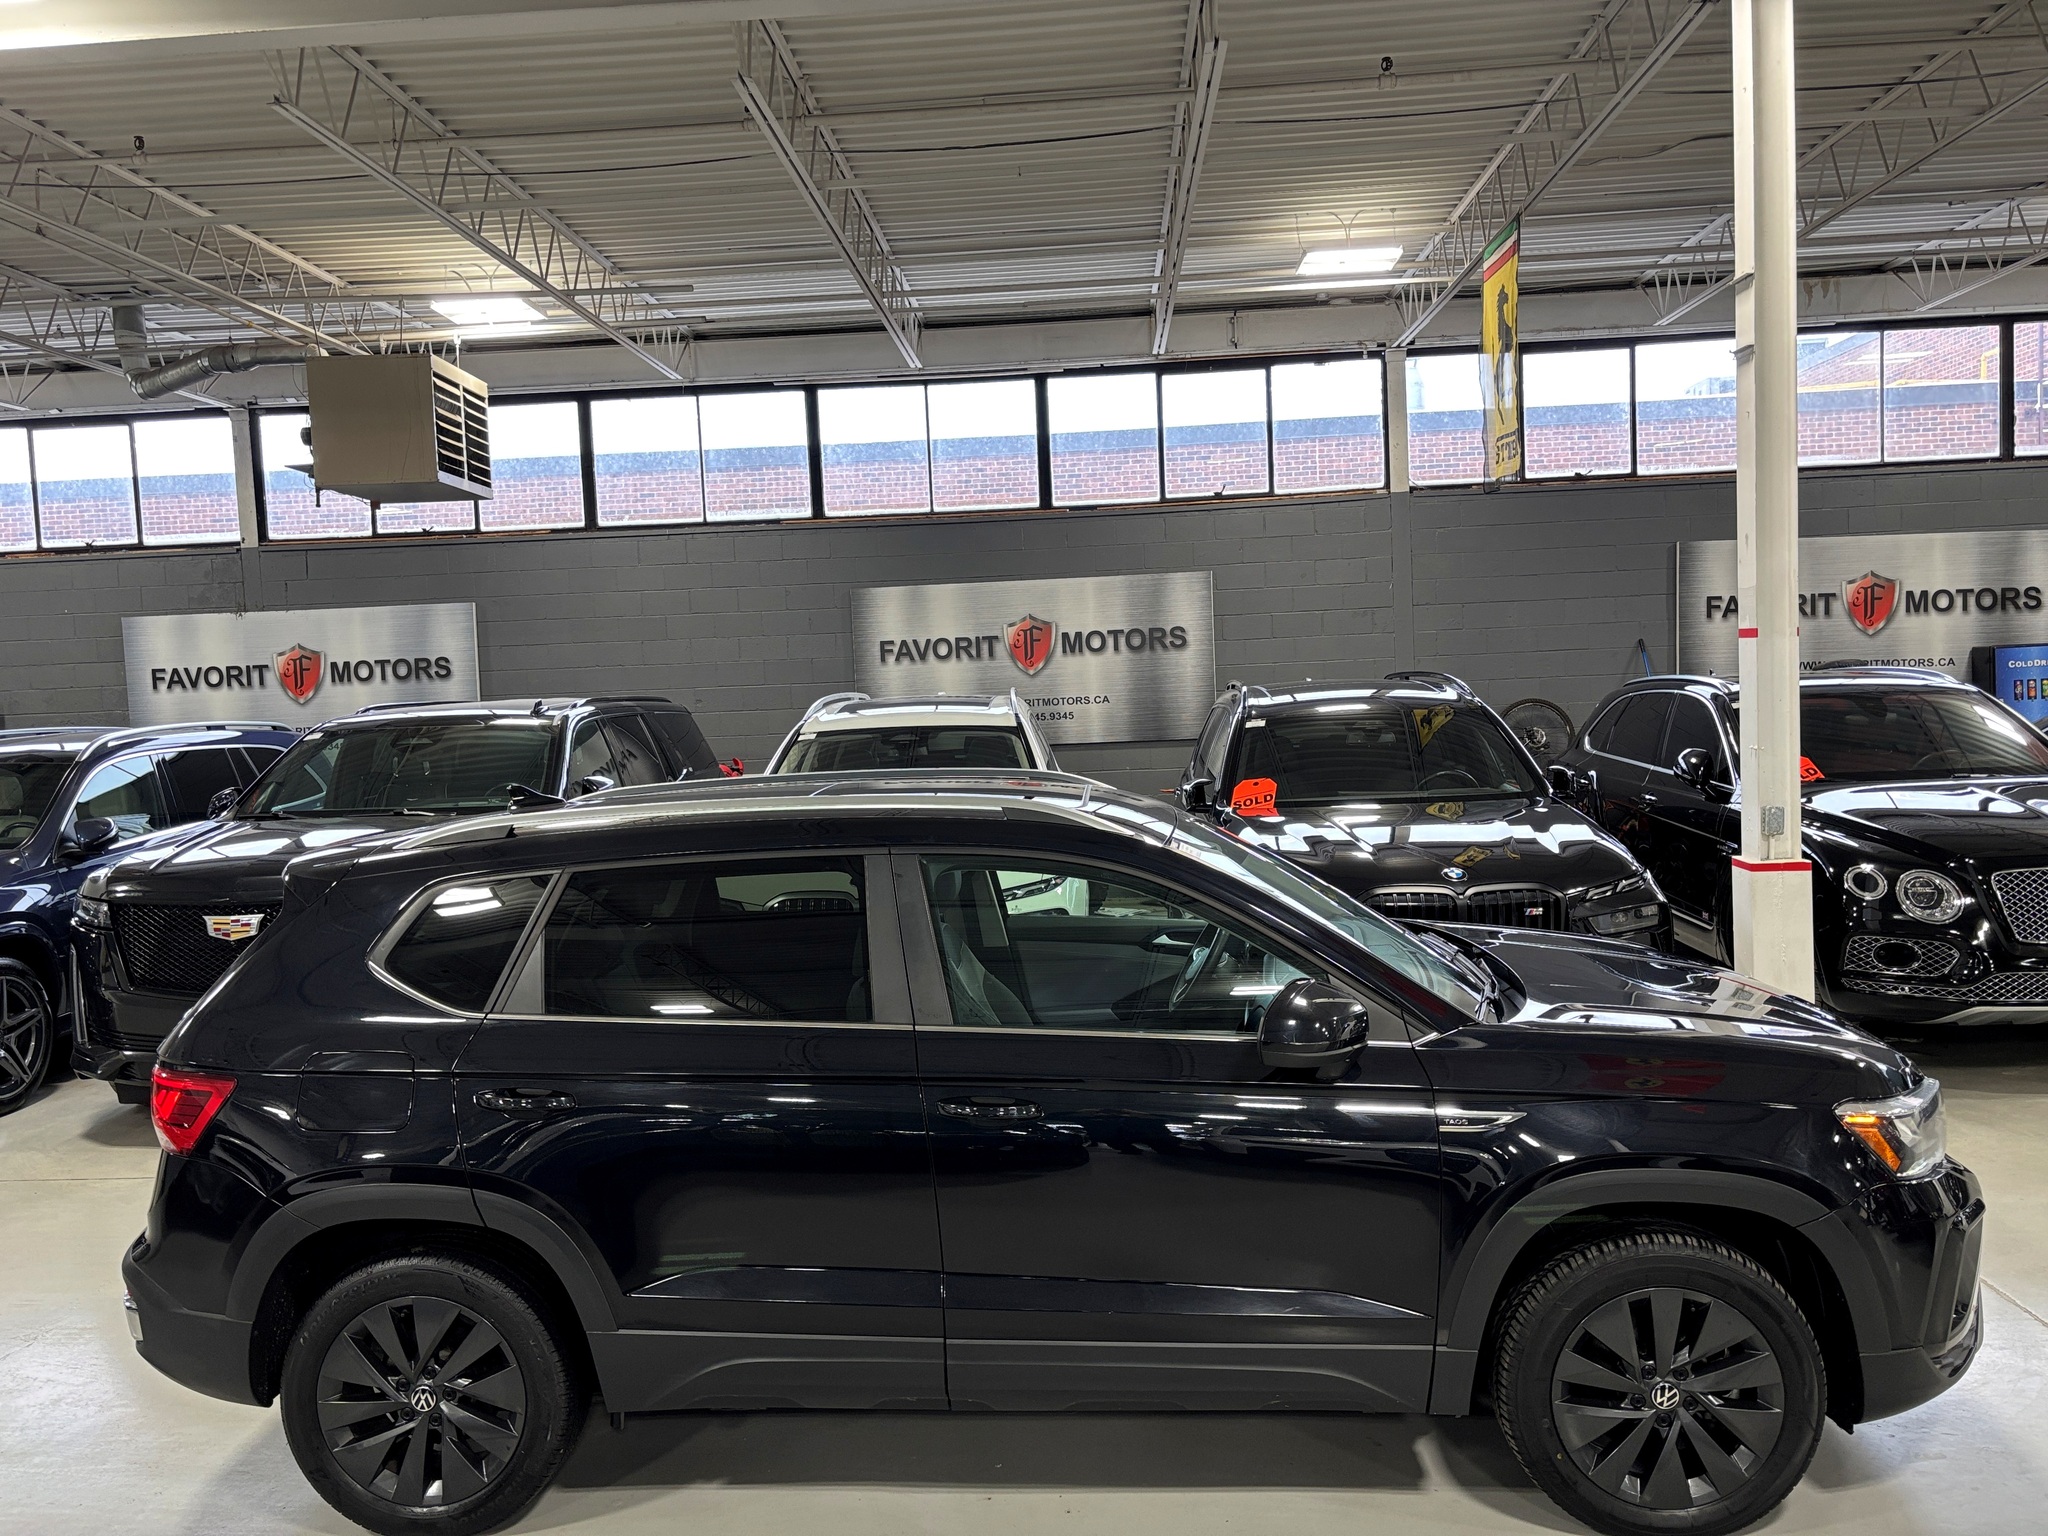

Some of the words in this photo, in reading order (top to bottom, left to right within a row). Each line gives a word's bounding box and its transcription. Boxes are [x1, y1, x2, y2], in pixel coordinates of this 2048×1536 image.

[1706, 592, 1837, 619] FARIT
[1905, 587, 2042, 614] MOTORS
[879, 635, 999, 663] FAVORIT
[1061, 626, 1187, 654] MOTORS
[151, 664, 269, 690] FAVORIT
[331, 656, 452, 683] MOTORS
[1024, 695, 1110, 707] RITMOTORS.CA
[1035, 711, 1075, 721] 45.9345
[1233, 793, 1274, 809] SOLD
